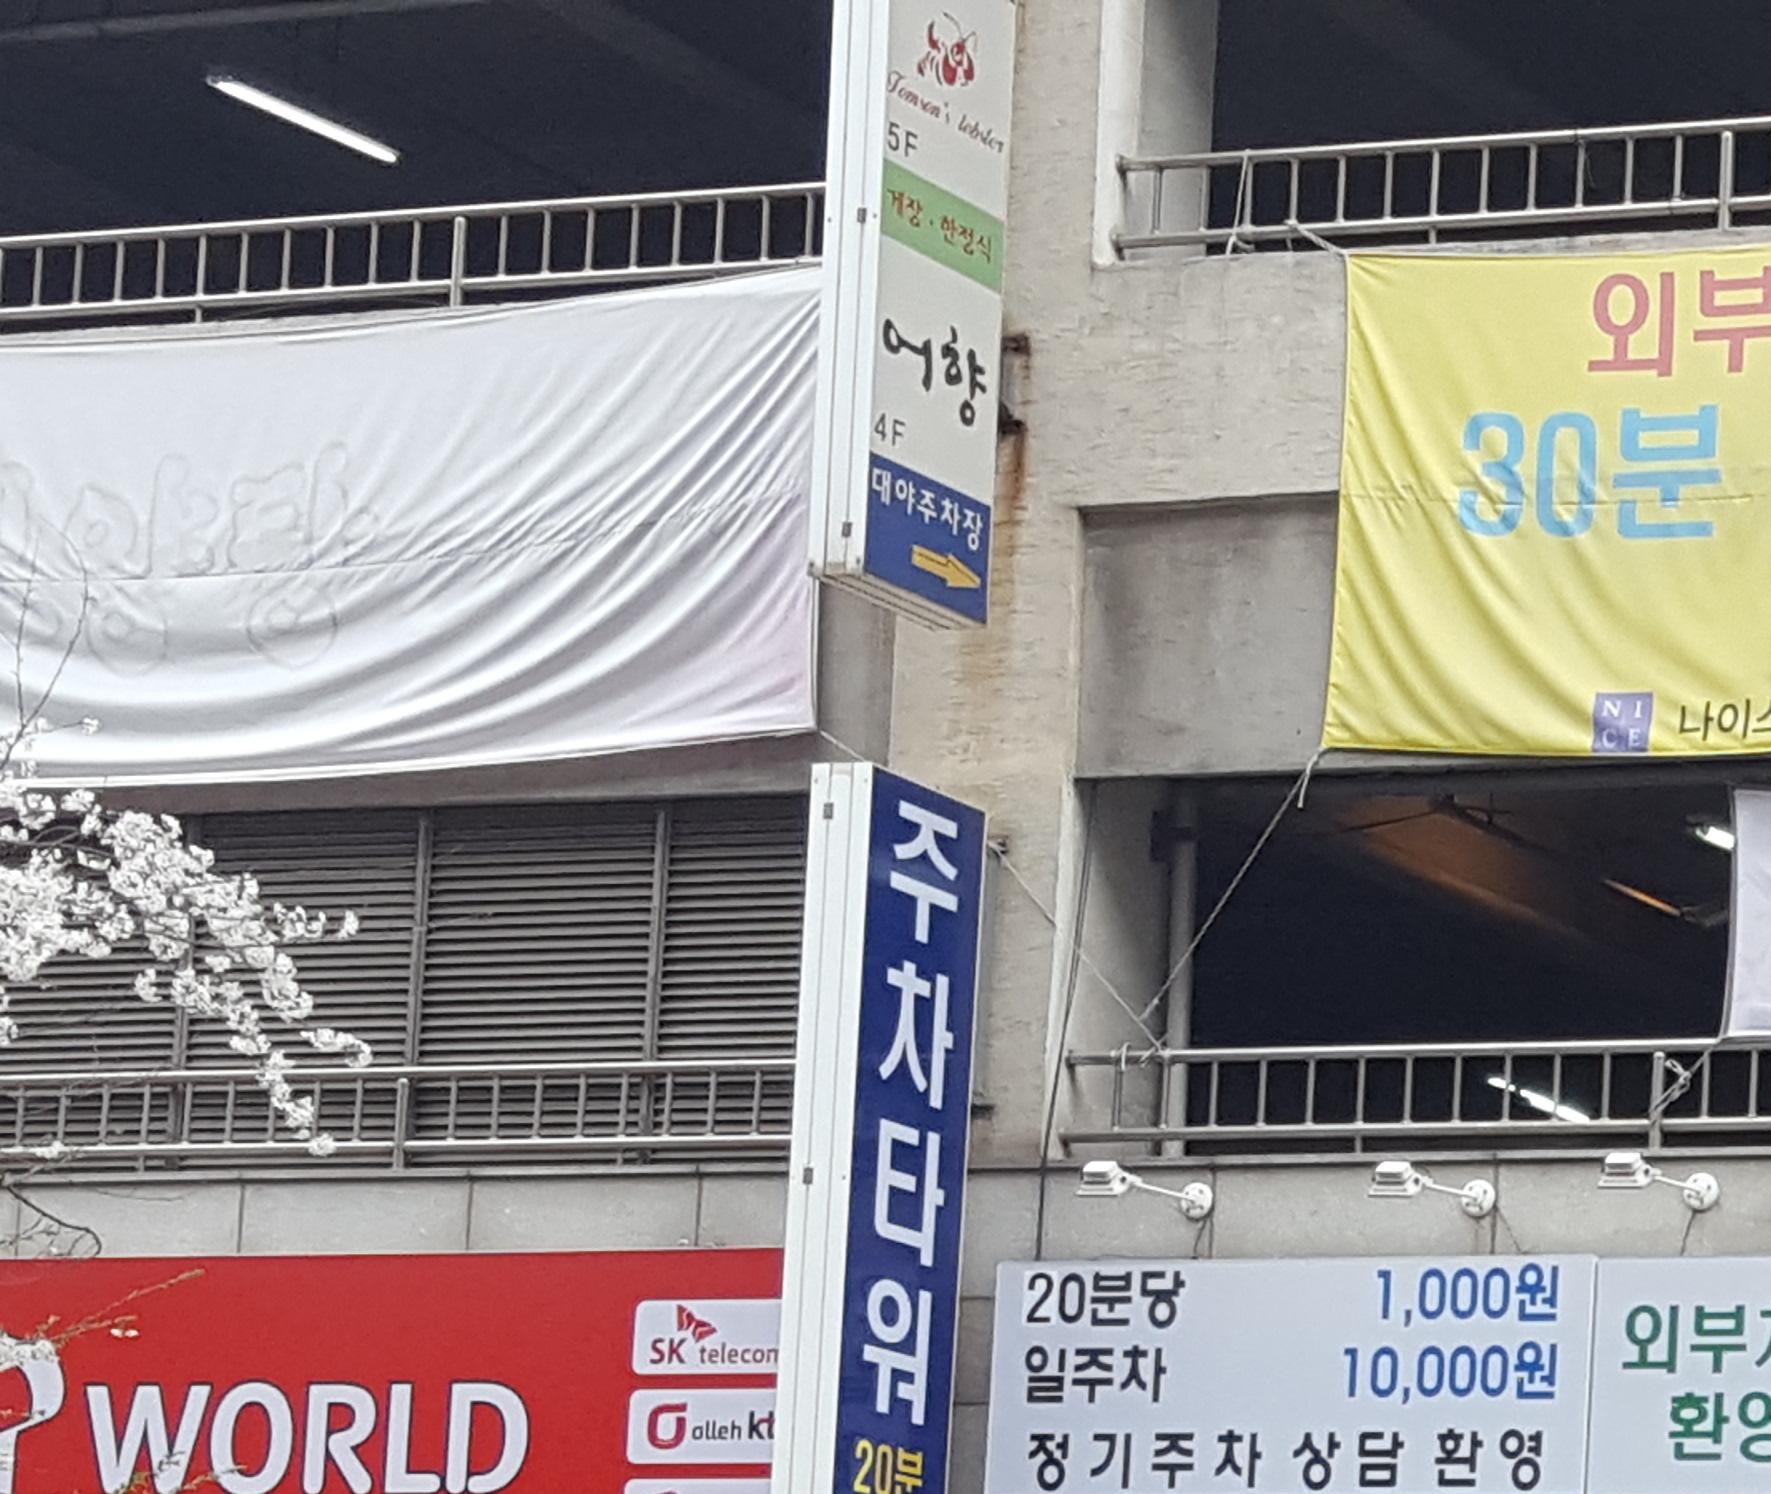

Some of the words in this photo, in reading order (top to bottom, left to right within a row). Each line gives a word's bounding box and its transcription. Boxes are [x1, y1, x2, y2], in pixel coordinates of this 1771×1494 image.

[888, 122, 918, 157] 5F
[882, 317, 987, 428] 어향
[873, 411, 907, 446] 4F
[1457, 402, 1723, 542] 30분
[871, 467, 984, 552] 대야주차장
[861, 800, 959, 1427] 주차타워
[1024, 1269, 1187, 1328] 20분당
[1375, 1264, 1561, 1328] 1,000원
[649, 1338, 687, 1365] SK
[1024, 1345, 1167, 1404] 일주차
[1341, 1342, 1561, 1405] 10,000원
[692, 1420, 742, 1441] olleh
[1027, 1430, 1264, 1492] 정기주차
[1291, 1429, 1406, 1490] 상담
[1434, 1428, 1545, 1492] 환영
